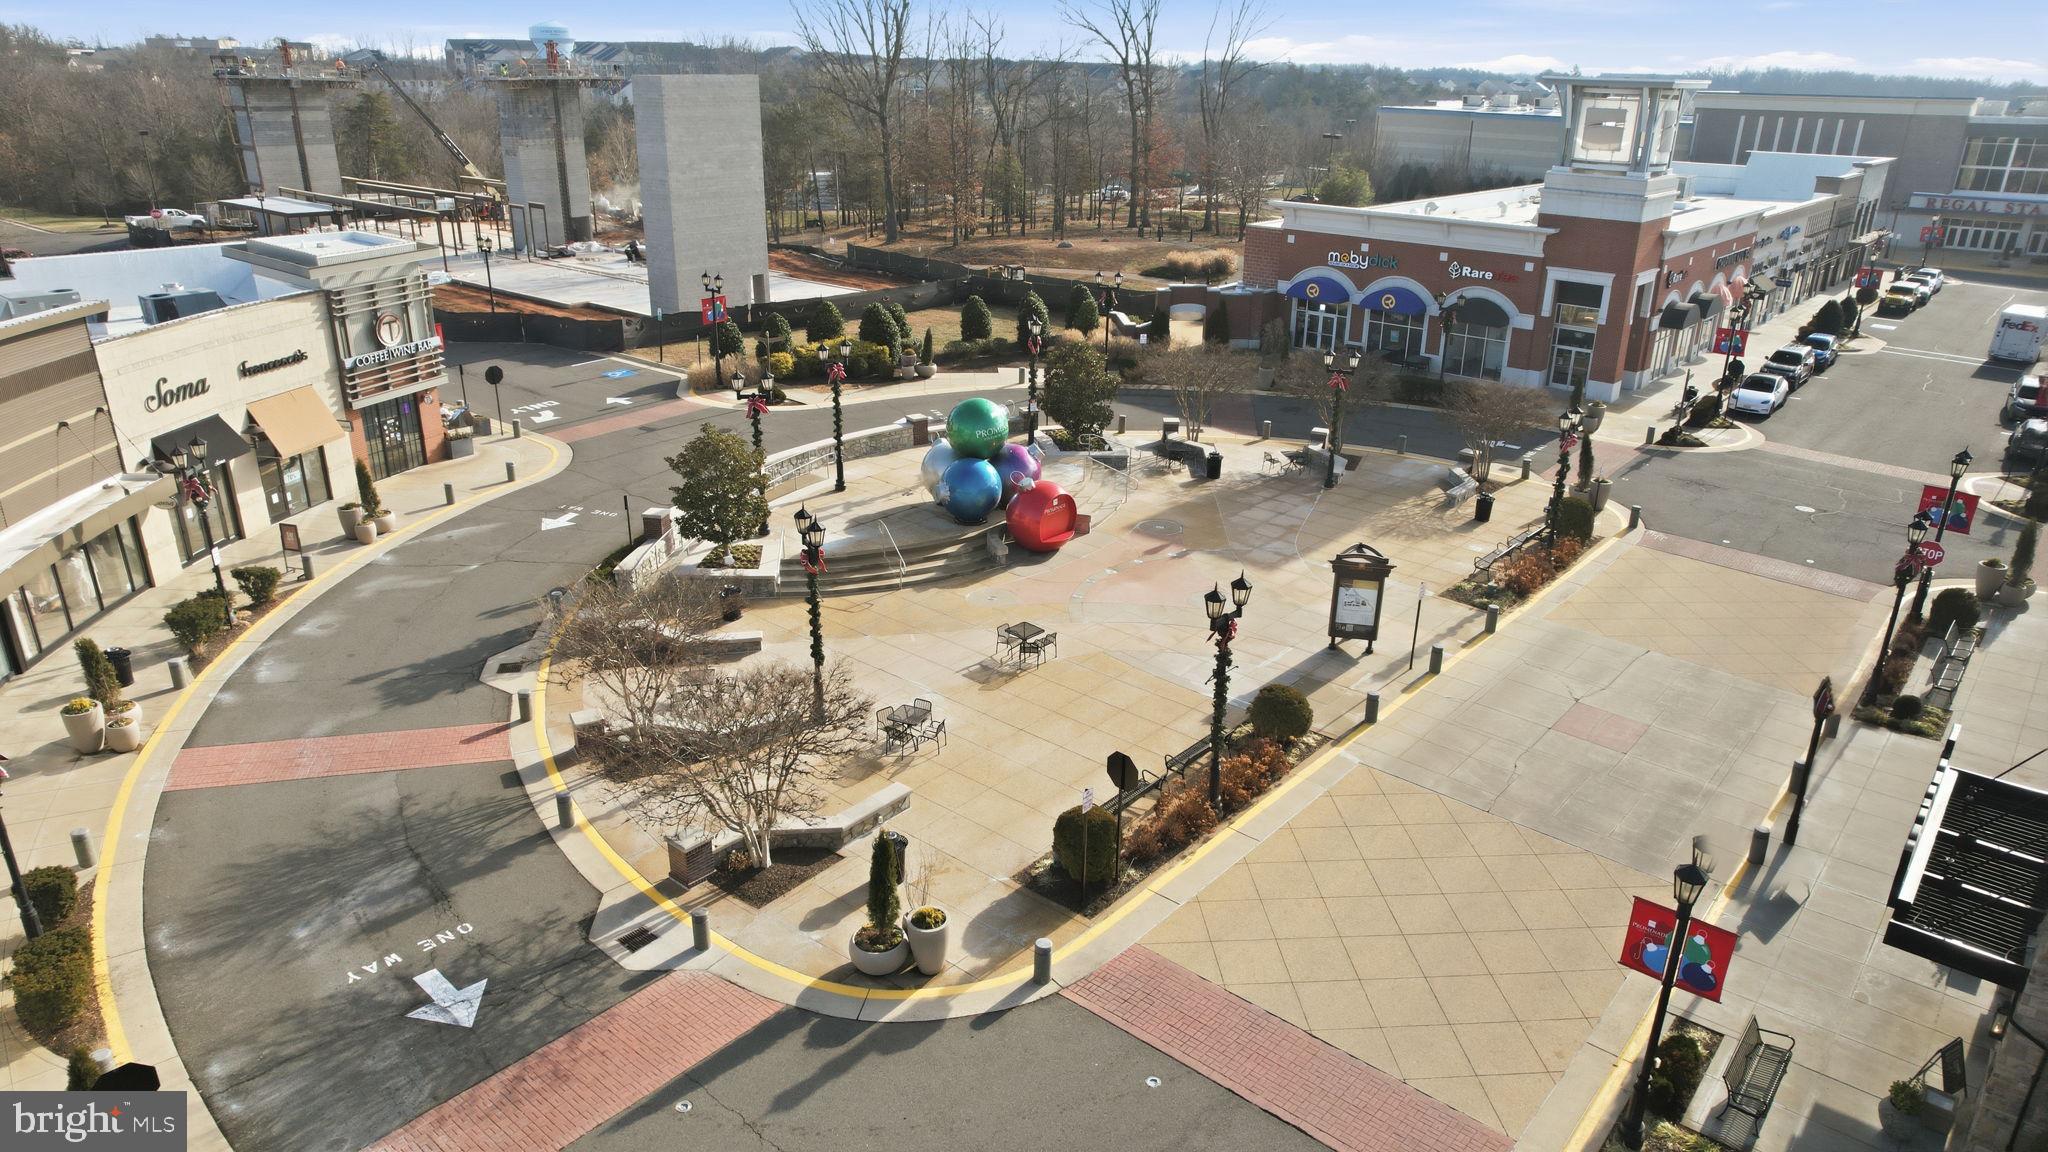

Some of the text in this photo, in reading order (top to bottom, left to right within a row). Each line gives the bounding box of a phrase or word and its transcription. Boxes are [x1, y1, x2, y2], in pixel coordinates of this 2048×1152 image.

[1924, 197, 1991, 214] REGAL
[144, 377, 210, 413] Soma
[1921, 547, 1943, 561] TOP
[346, 922, 474, 985] ONE WAY
